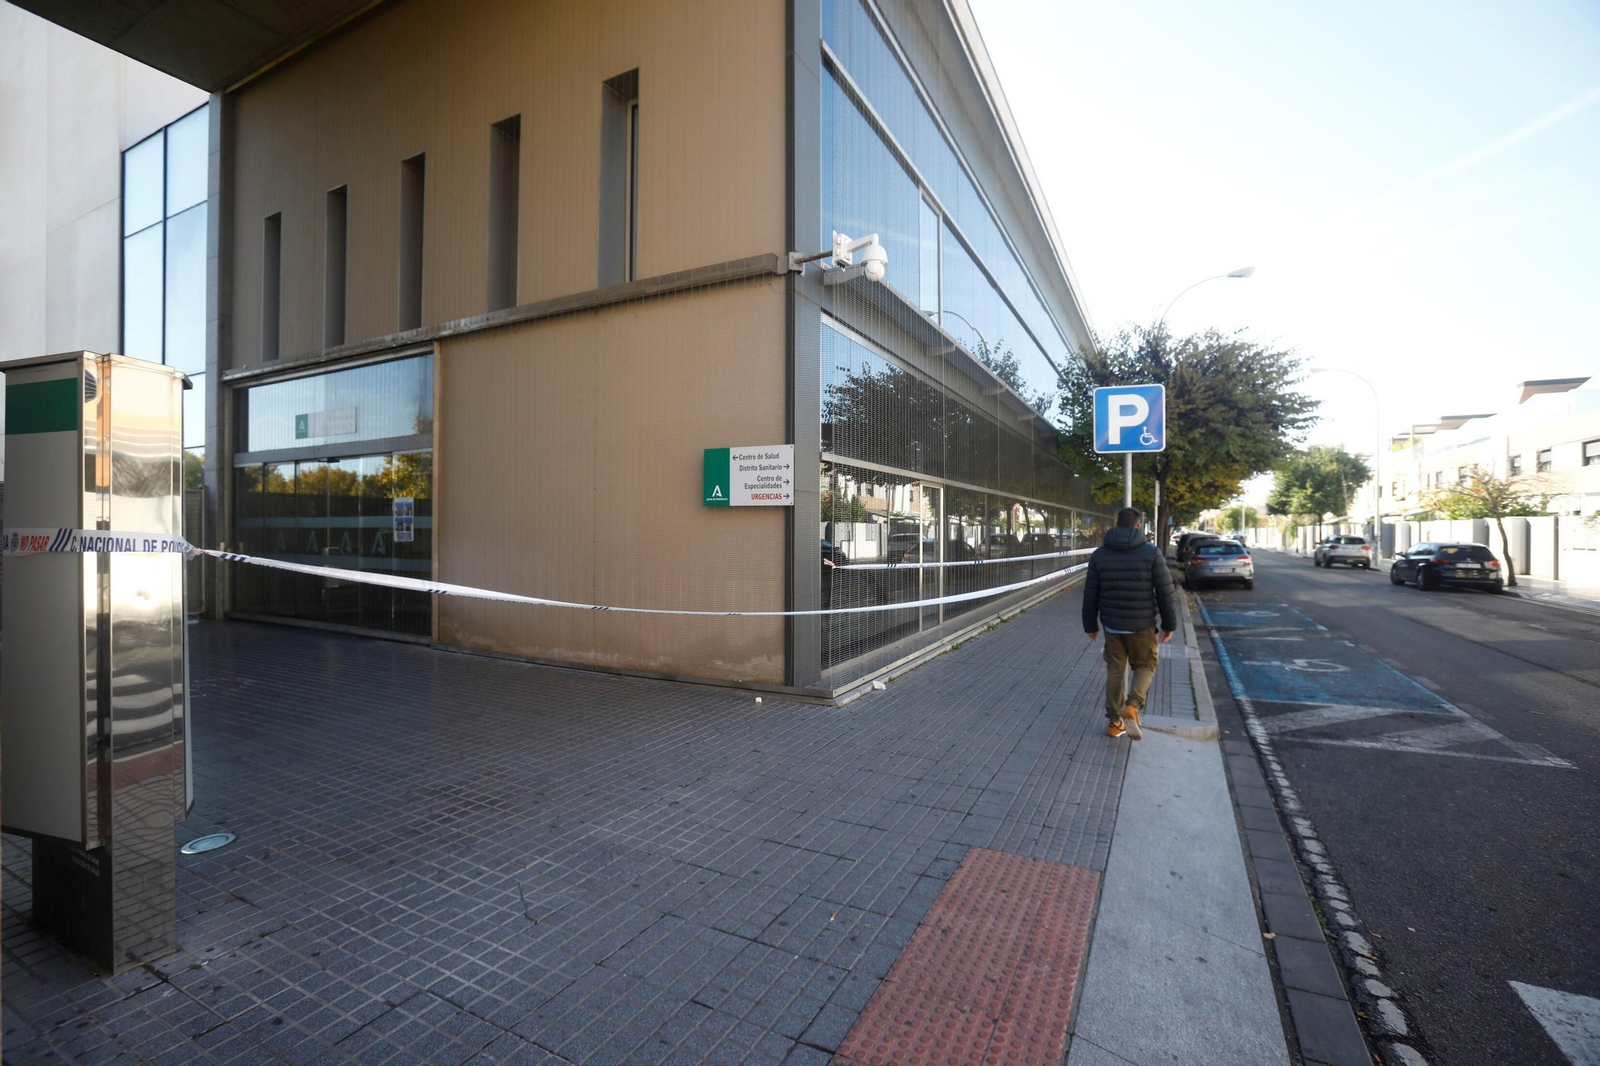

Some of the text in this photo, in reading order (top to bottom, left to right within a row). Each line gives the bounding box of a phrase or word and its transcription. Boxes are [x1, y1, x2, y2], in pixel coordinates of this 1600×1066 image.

[1108, 394, 1149, 445] P
[30, 535, 50, 551] PASAR
[80, 536, 136, 552] NACIONAL
